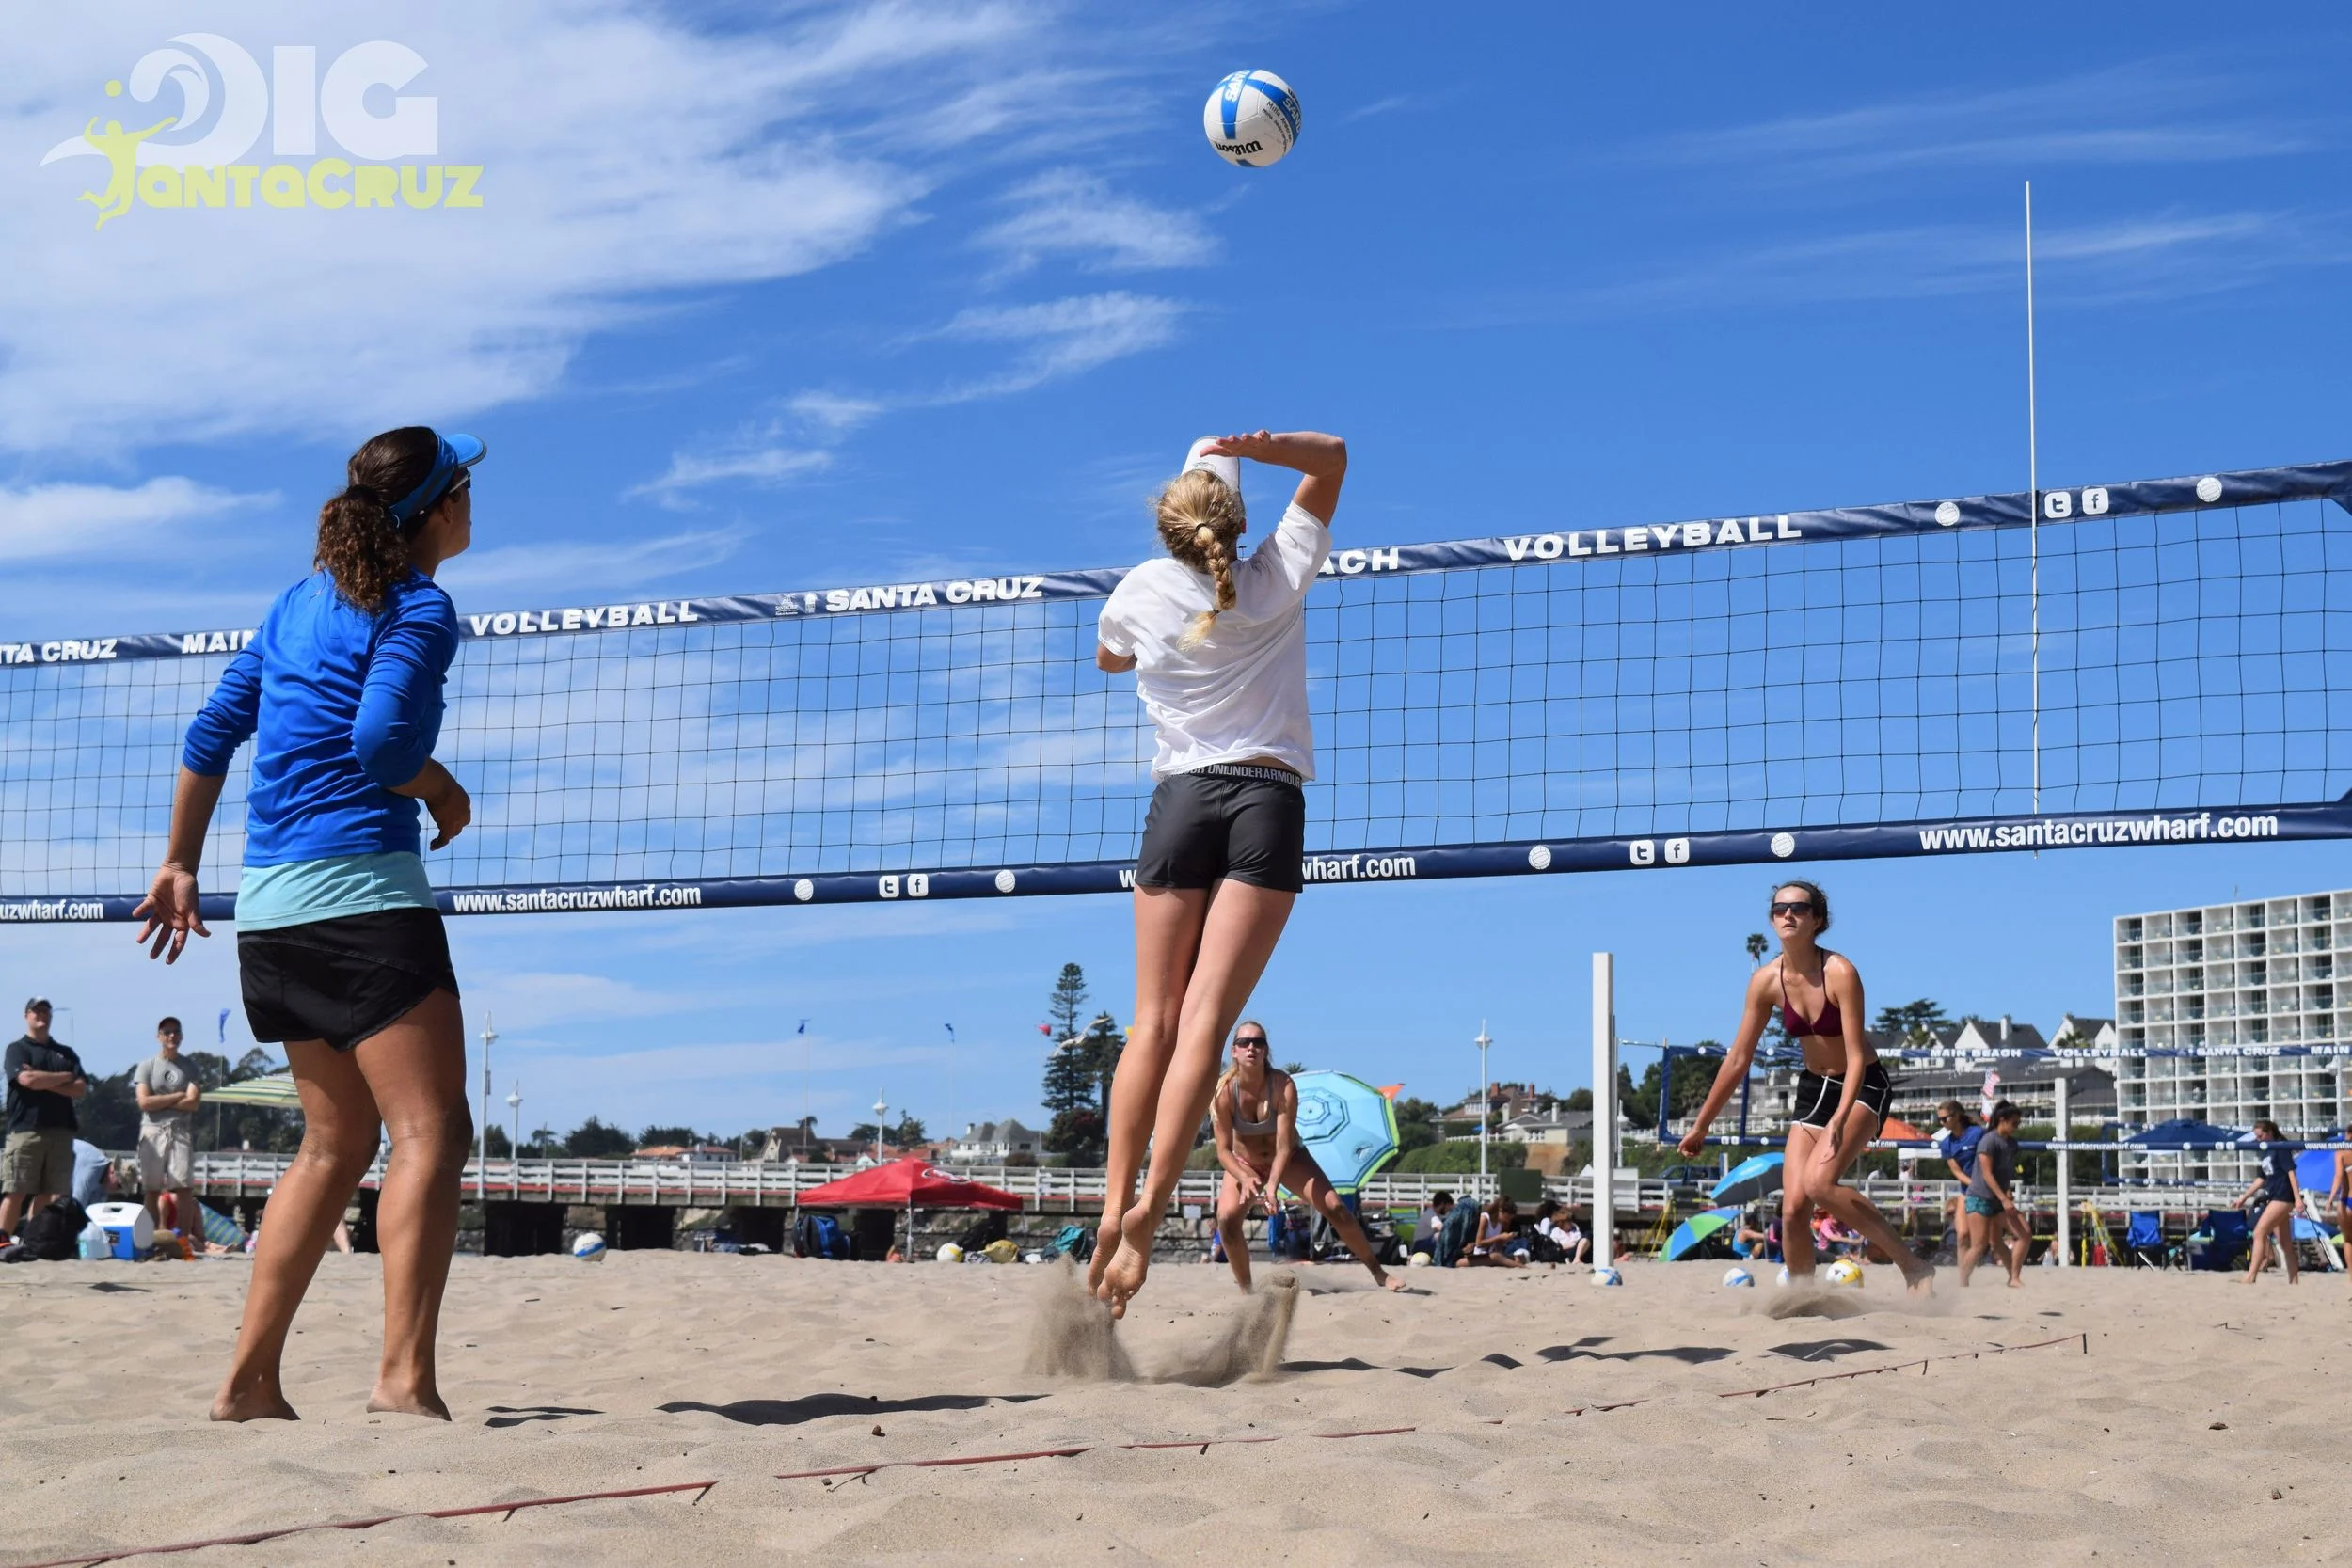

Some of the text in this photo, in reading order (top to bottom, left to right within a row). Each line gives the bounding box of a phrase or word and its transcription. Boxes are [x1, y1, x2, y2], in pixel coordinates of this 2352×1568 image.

[1214, 140, 1263, 155] Wilson
[1503, 515, 1802, 562] VOLLEYBALL
[1319, 547, 1399, 575] ACH
[826, 584, 937, 611] SANTA
[946, 577, 1044, 603] CRUZ
[470, 601, 698, 636] VOLLEYBALL
[0, 640, 118, 664] TA CRUZ
[1919, 812, 2278, 850] www.santacruzwharf.com
[453, 884, 702, 912] www.santacruzwharf.com
[1931, 1048, 2147, 1057] MAIN BEACH VOLLEYBALL
[2197, 1045, 2350, 1056] SANTA CRUZ MAIN
